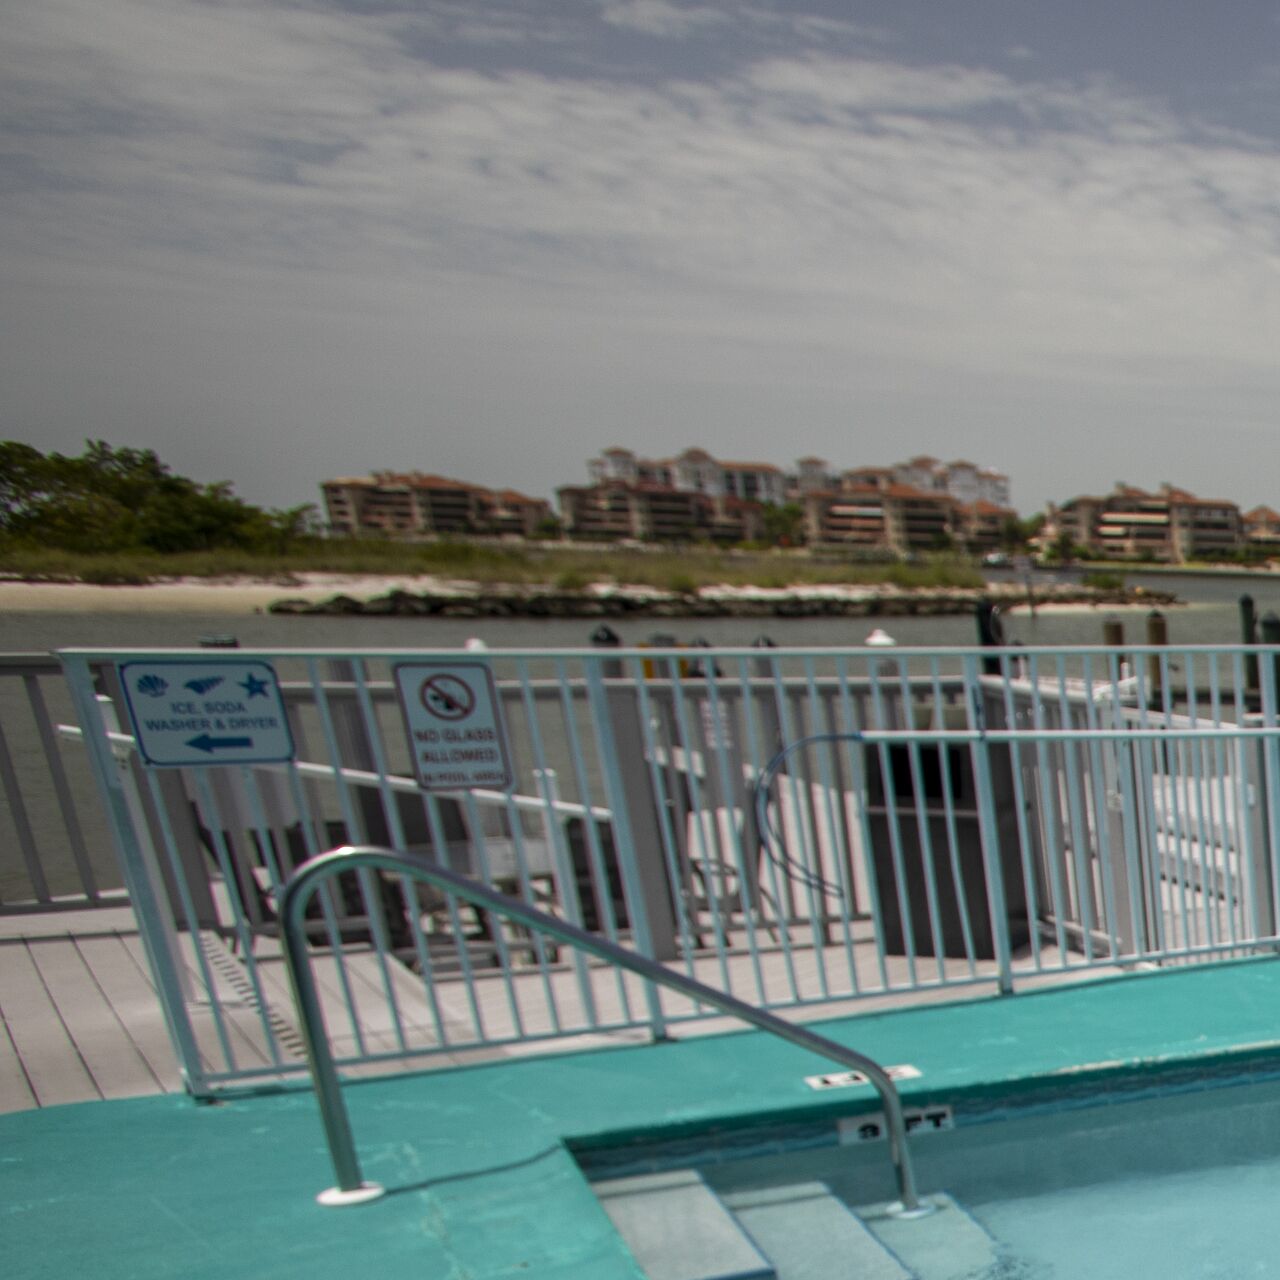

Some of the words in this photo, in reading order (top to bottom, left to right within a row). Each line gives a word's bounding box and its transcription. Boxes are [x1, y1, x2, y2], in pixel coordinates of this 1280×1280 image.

[205, 702, 247, 713] SODA
[145, 718, 211, 731] WASHER
[216, 718, 226, 729] &
[230, 717, 278, 729] DRYER
[415, 731, 439, 741] NO
[443, 729, 496, 742] GLASS
[423, 747, 499, 762] ALLOWED
[904, 1110, 947, 1131] FT
